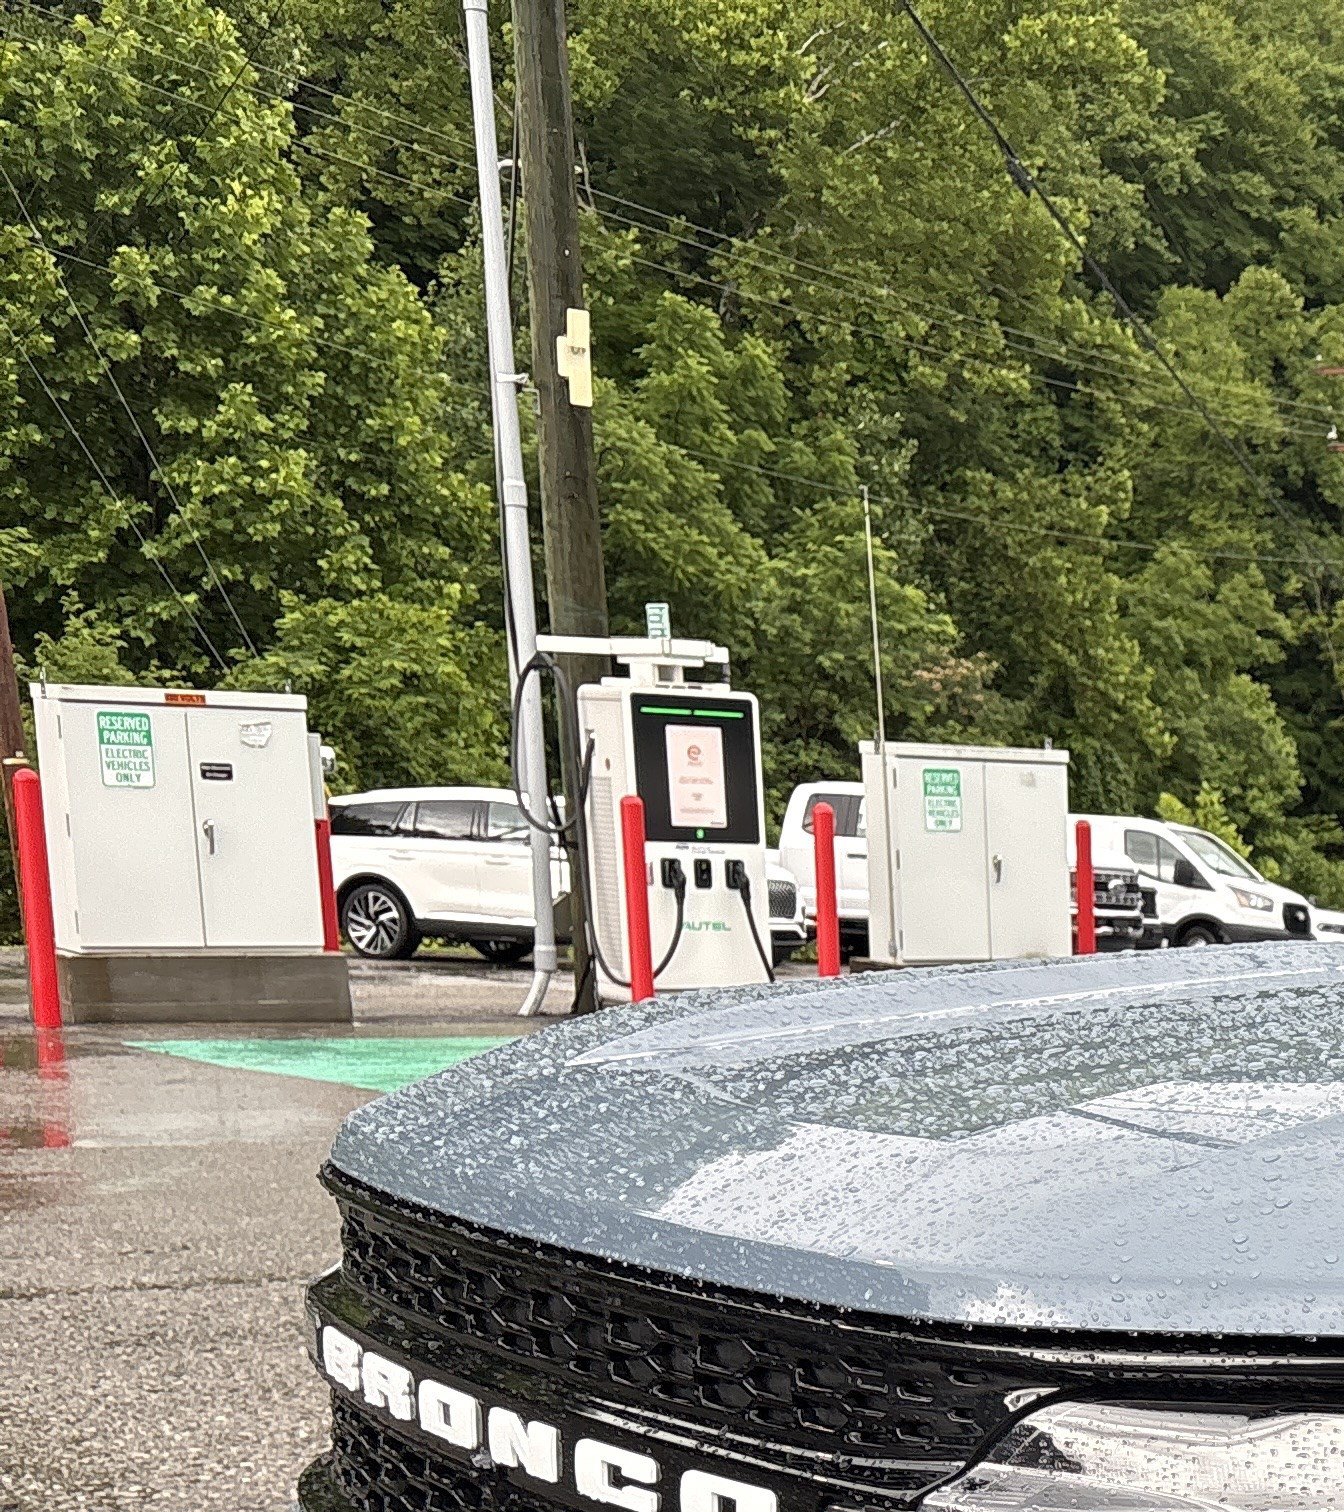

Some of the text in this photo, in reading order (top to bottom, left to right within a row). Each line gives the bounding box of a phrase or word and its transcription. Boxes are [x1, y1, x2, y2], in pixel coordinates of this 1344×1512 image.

[99, 715, 149, 730] RESERVED
[103, 730, 148, 745] PARKING
[105, 748, 148, 760] ELECTRIC
[105, 760, 151, 772] VEHICLES
[116, 772, 142, 783] ONLY
